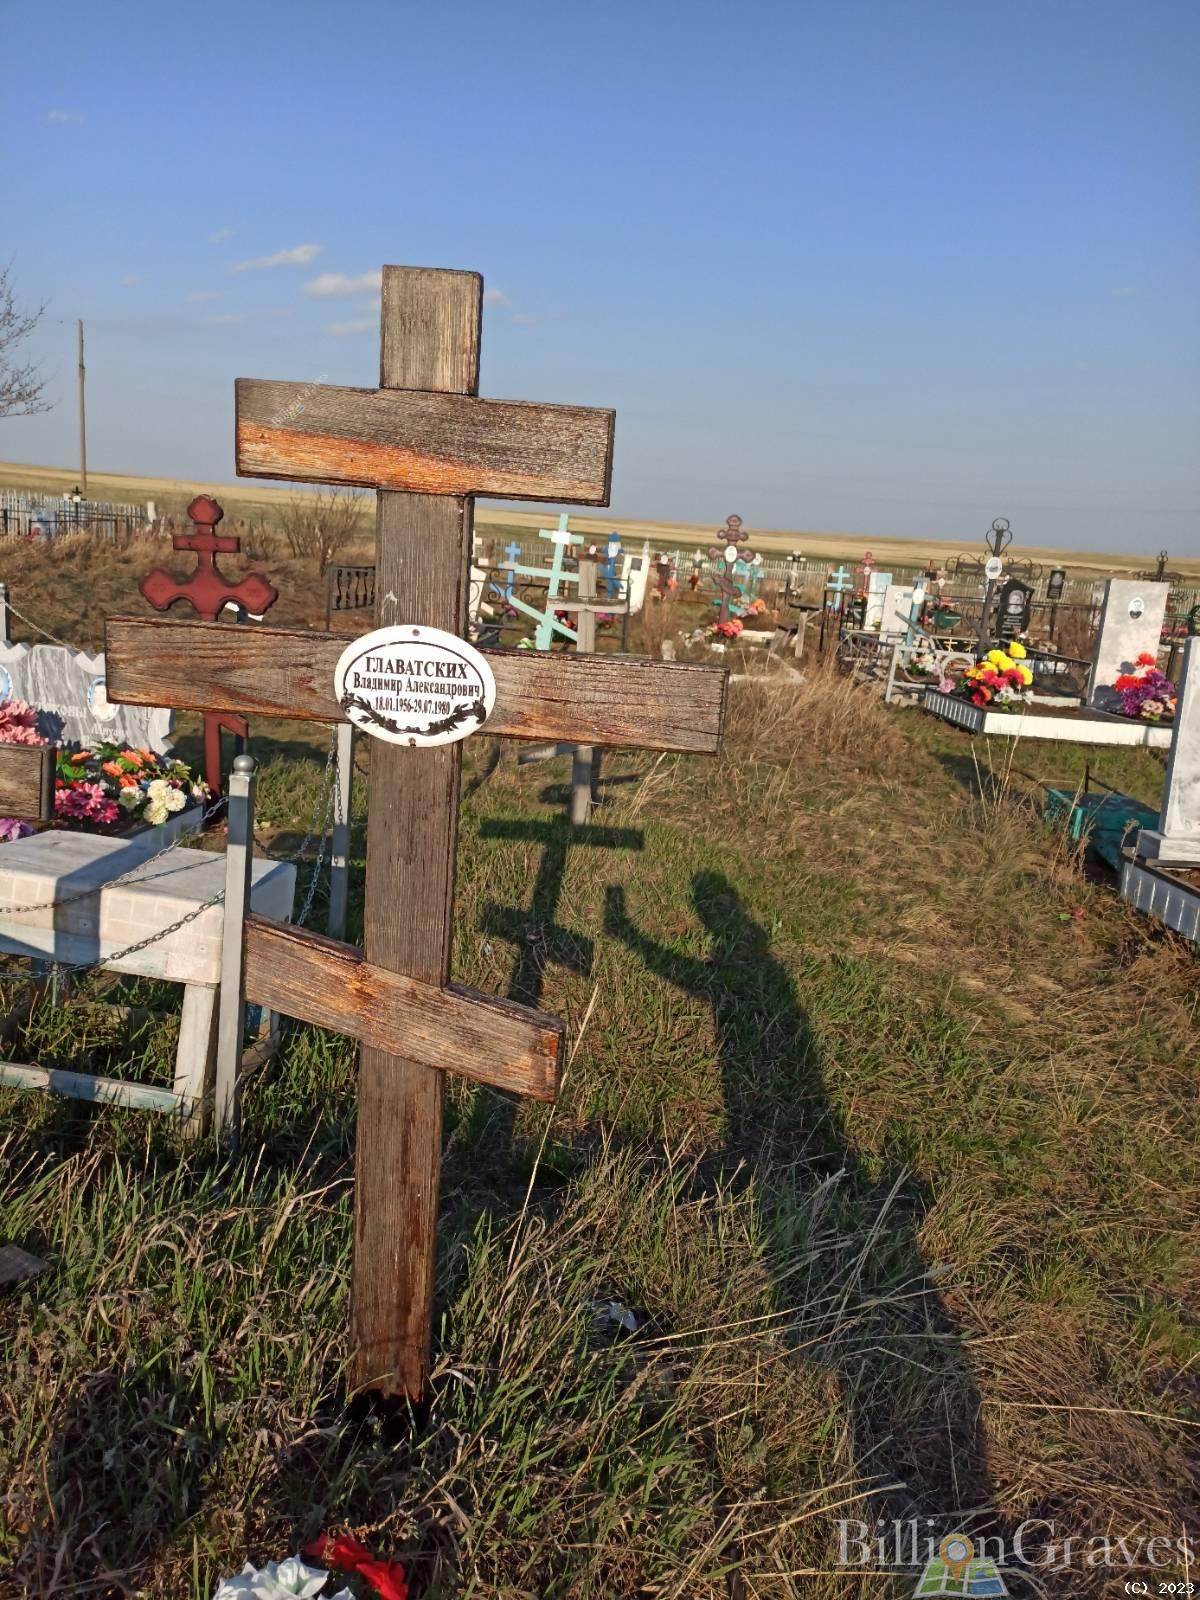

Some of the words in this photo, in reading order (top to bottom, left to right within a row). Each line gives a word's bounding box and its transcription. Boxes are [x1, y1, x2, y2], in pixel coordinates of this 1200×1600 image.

[366, 657, 468, 679] ГЛАВАТСКИХ
[353, 672, 403, 697] Владимир
[405, 677, 480, 699] Александрович
